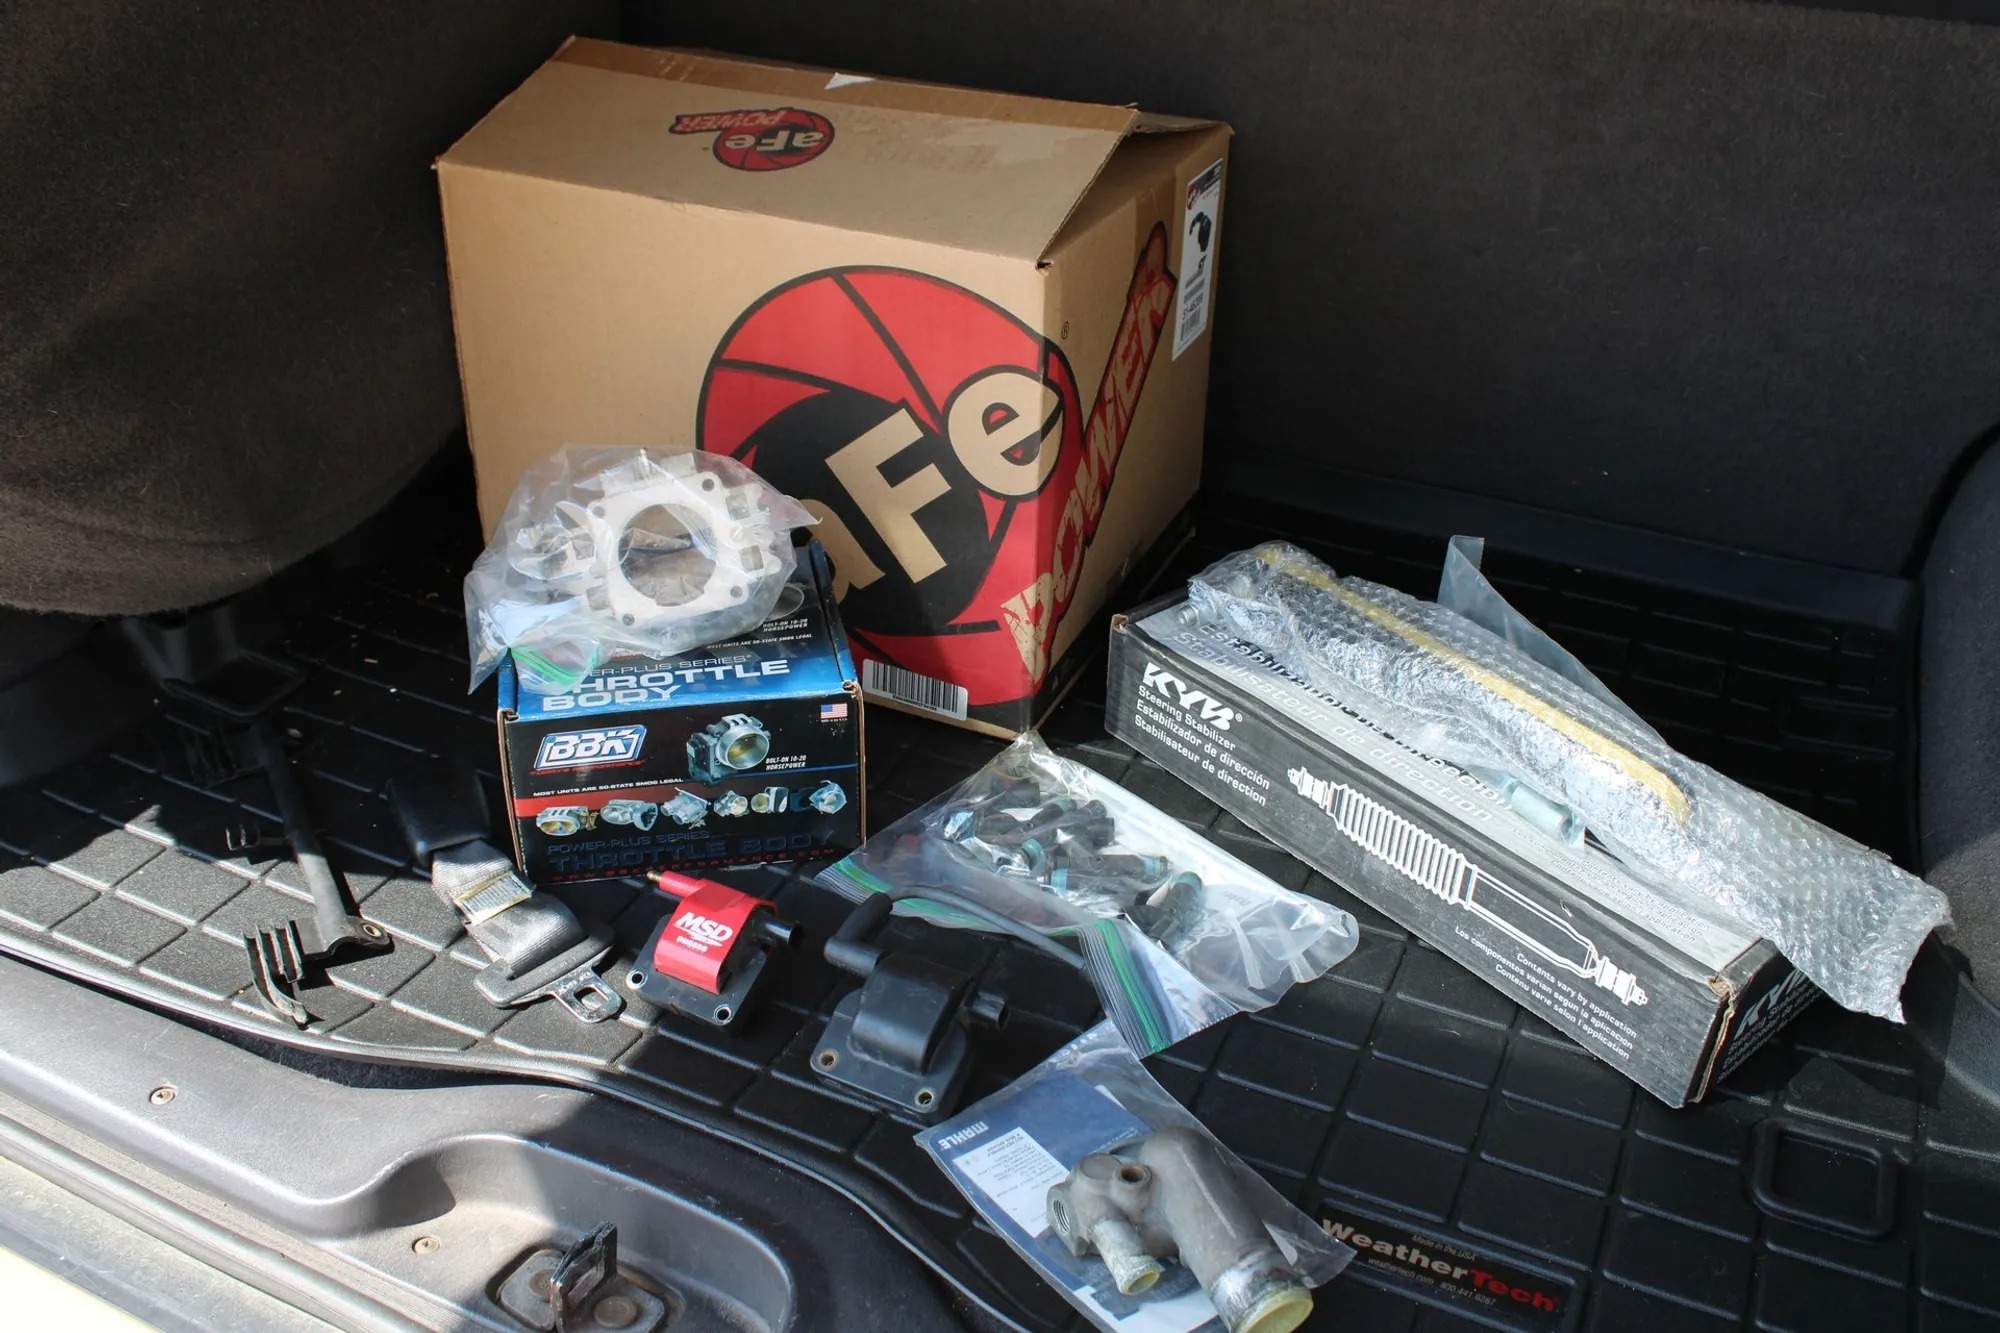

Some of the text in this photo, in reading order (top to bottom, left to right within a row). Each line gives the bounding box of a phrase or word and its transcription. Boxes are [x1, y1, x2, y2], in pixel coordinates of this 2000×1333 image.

[725, 130, 824, 151] aFe
[1000, 230, 1173, 682] POWER
[572, 659, 790, 693] HROTTLE
[589, 655, 747, 677] ER-PLUS SERIES
[542, 684, 682, 711] BODY
[1143, 662, 1234, 730] KYB
[1138, 685, 1236, 751] Steering Stabilizer
[1174, 631, 1493, 821] Stabilisateur de direction
[546, 729, 638, 762] BBK
[765, 756, 789, 764] BOLT-ON
[1135, 714, 1266, 806] Stabilisateur de direction
[1136, 699, 1269, 790] Estabilizador de dirección
[765, 762, 806, 771] HORSEPOWER
[557, 787, 579, 795] UNITS
[547, 830, 710, 855] POWER-PLUS SERIES
[549, 829, 834, 873] THROTTLE BODY
[674, 911, 733, 941] MSD
[1455, 925, 1469, 940] Los
[1471, 938, 1525, 976] componentes
[1526, 973, 1552, 994] varian
[1553, 992, 1579, 1012] segun
[1580, 1008, 1589, 1018] la
[1495, 964, 1530, 991] Contenu
[1531, 989, 1552, 1006] varie
[1553, 1004, 1576, 1023] selon
[1517, 953, 1637, 1038] Contents vary by application
[937, 1121, 989, 1151] MAHLE
[1322, 1218, 1557, 1312] WeatherTech
